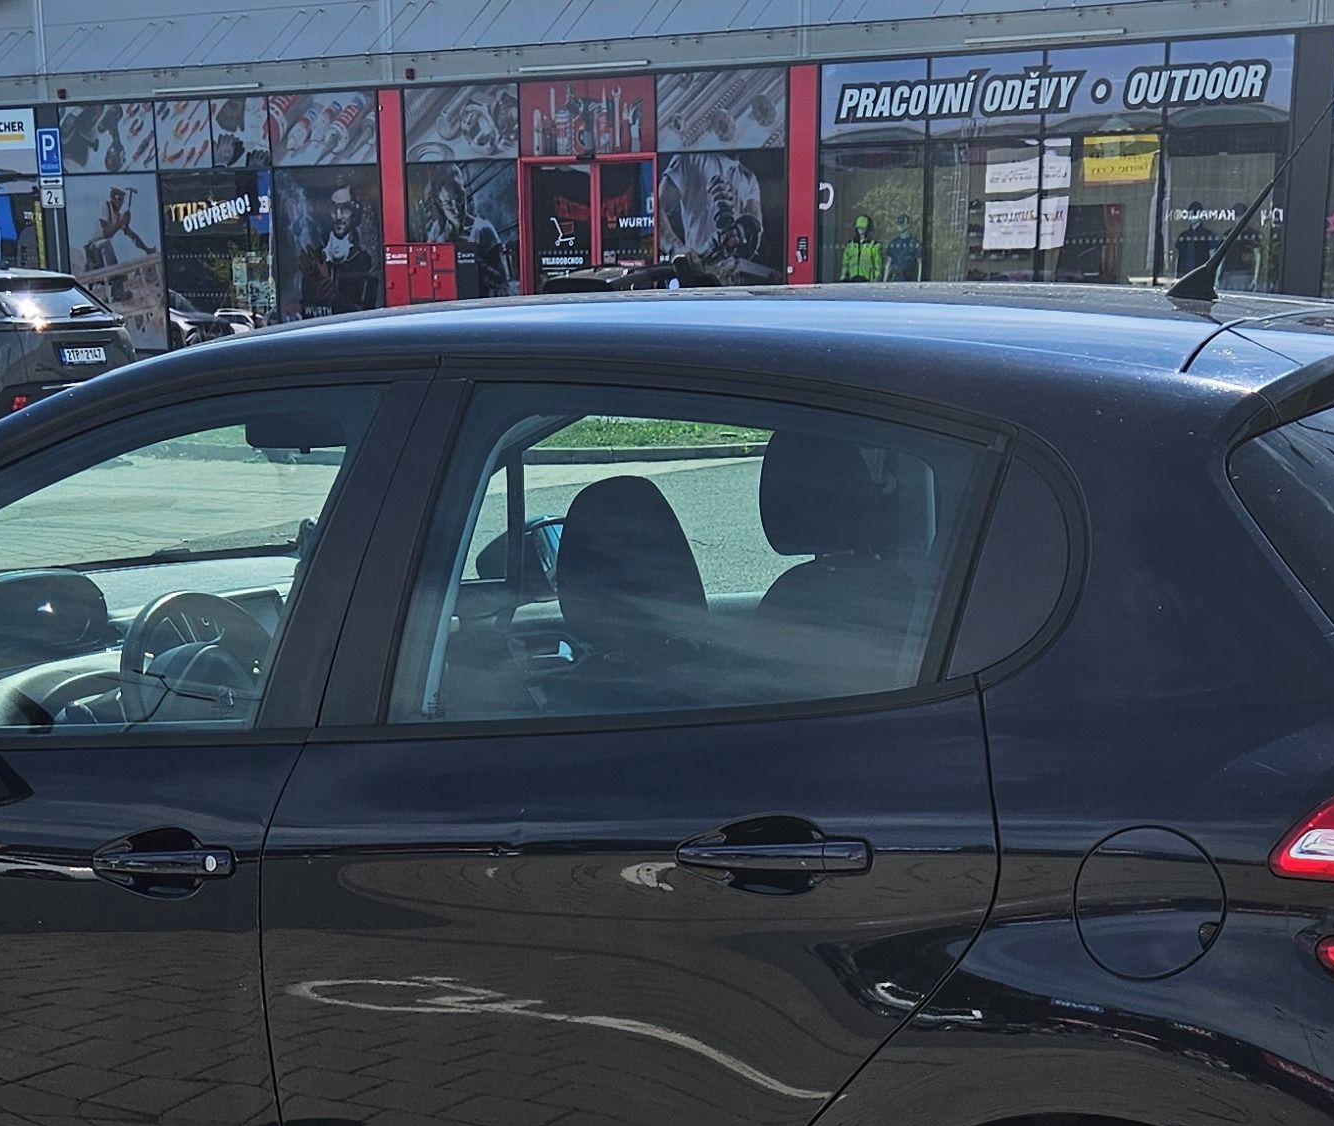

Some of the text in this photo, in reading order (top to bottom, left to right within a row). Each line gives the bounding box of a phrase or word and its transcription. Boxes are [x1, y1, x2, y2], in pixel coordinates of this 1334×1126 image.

[840, 64, 1266, 119] PRACOVNÍ ODĚVY OUTDOOR
[42, 134, 55, 161] P
[182, 194, 251, 233] OTEVŘENO!
